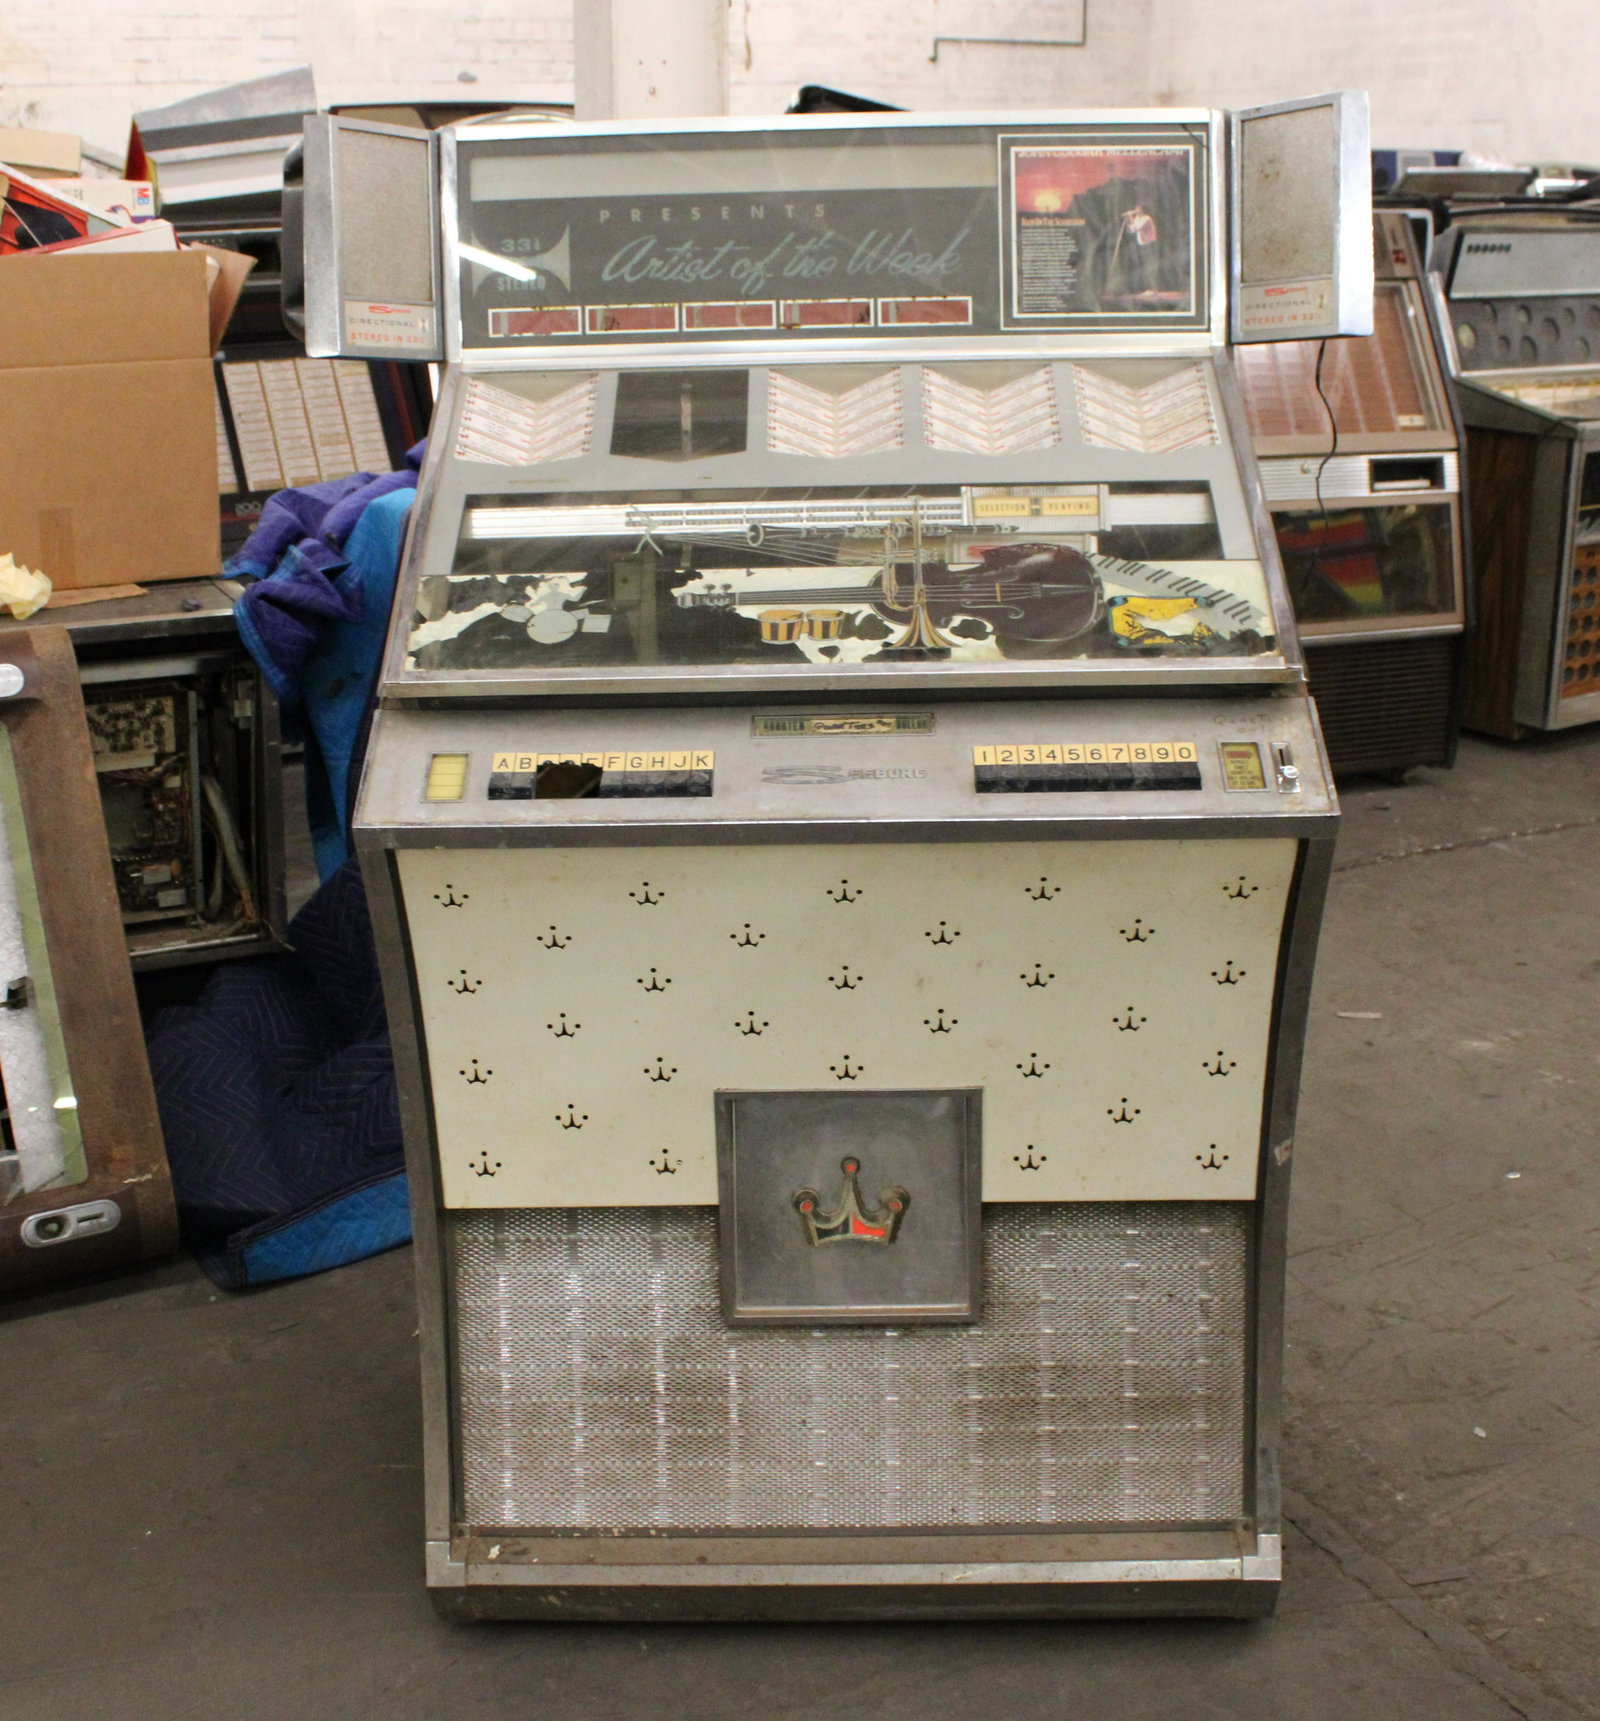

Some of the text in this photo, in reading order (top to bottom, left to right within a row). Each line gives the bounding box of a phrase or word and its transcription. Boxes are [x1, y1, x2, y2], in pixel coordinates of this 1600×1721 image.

[600, 203, 827, 223] PRESENTS
[602, 234, 752, 283] Artist
[729, 231, 797, 296] of
[782, 229, 839, 278] the
[846, 226, 972, 277] Week
[1245, 300, 1313, 310] DIRECTIONAL
[349, 317, 415, 328] DIRECTIONAL
[351, 332, 390, 341] STEREO
[980, 502, 1090, 511] SELECTION PLAYING
[1002, 750, 1013, 762] 2
[1023, 750, 1035, 762] 3
[1046, 750, 1057, 761] 4
[1068, 749, 1080, 760] 5
[1090, 748, 1102, 760] 6
[1113, 748, 1124, 760] 7
[1135, 748, 1147, 759] 8
[1157, 747, 1169, 759] 9
[497, 757, 510, 769] A
[519, 757, 532, 769] B
[607, 756, 620, 768] F
[630, 756, 643, 768] G
[652, 756, 665, 768] H
[674, 756, 687, 767] J
[696, 755, 709, 767] K
